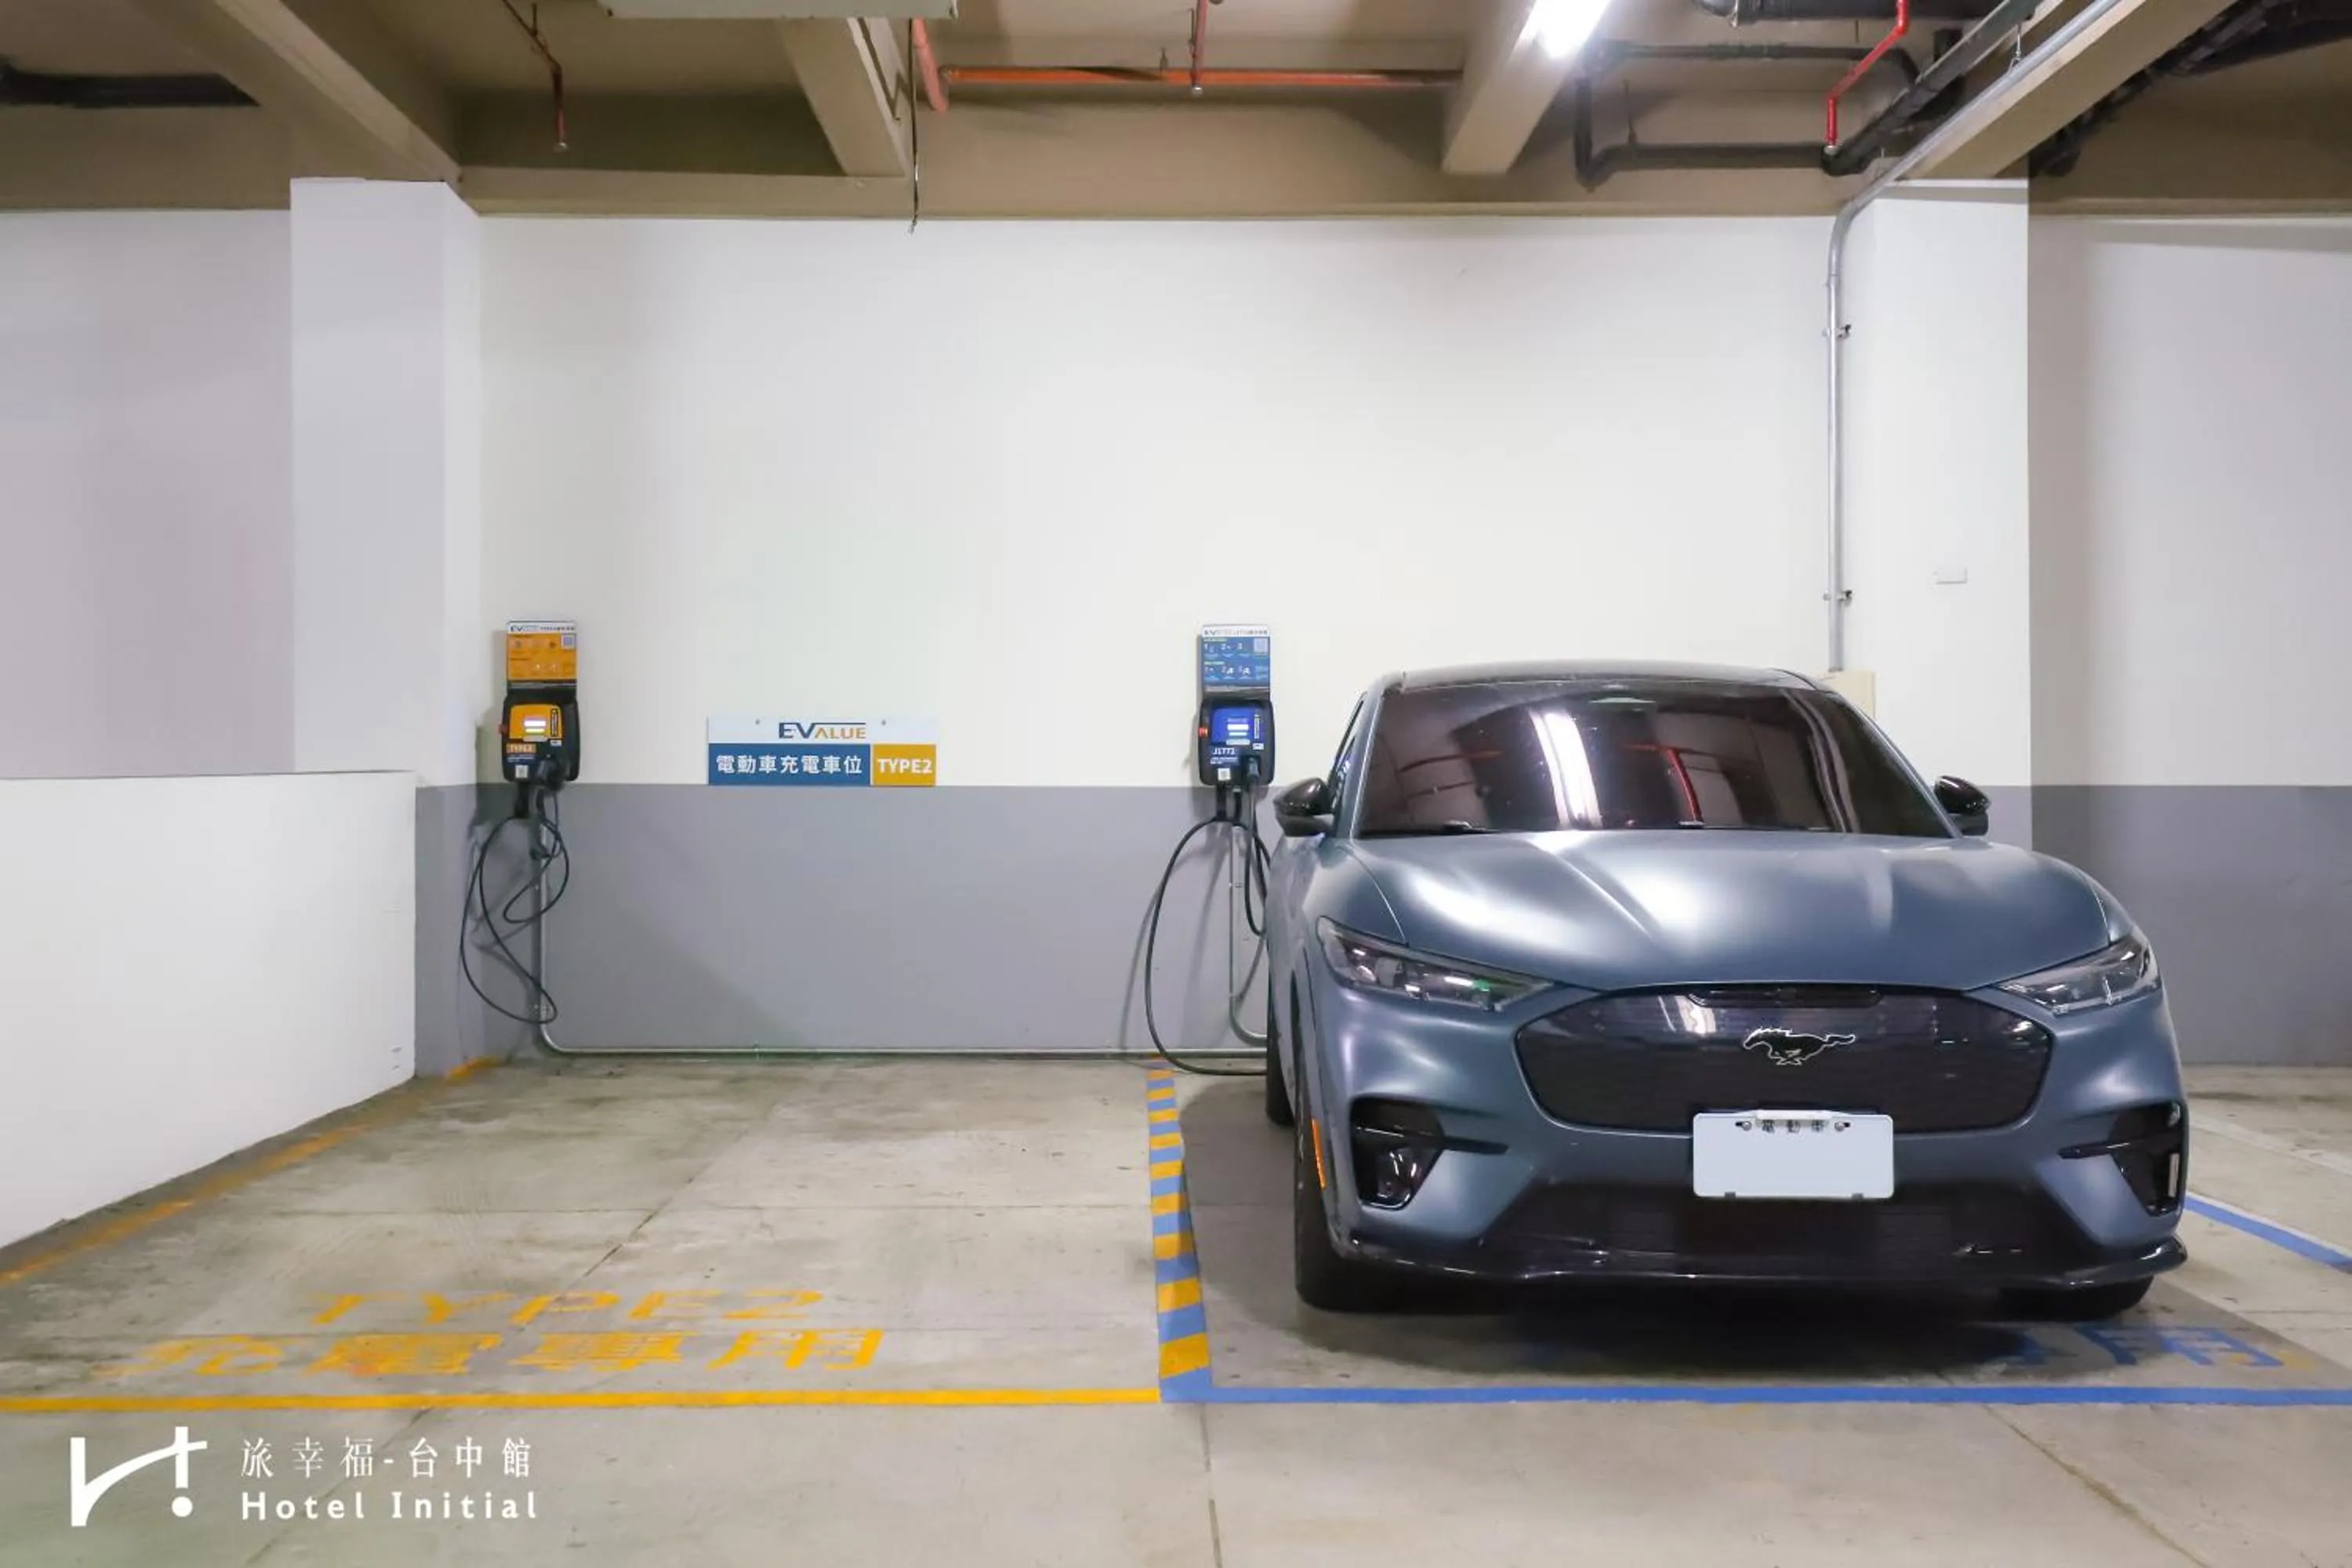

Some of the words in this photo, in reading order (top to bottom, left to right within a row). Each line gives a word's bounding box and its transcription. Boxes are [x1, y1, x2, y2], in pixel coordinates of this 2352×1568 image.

[779, 722, 866, 739] EVALUE
[716, 754, 863, 775] 電動車充電車位
[877, 757, 933, 774] TYPE2
[312, 1290, 823, 1326] TYPE2
